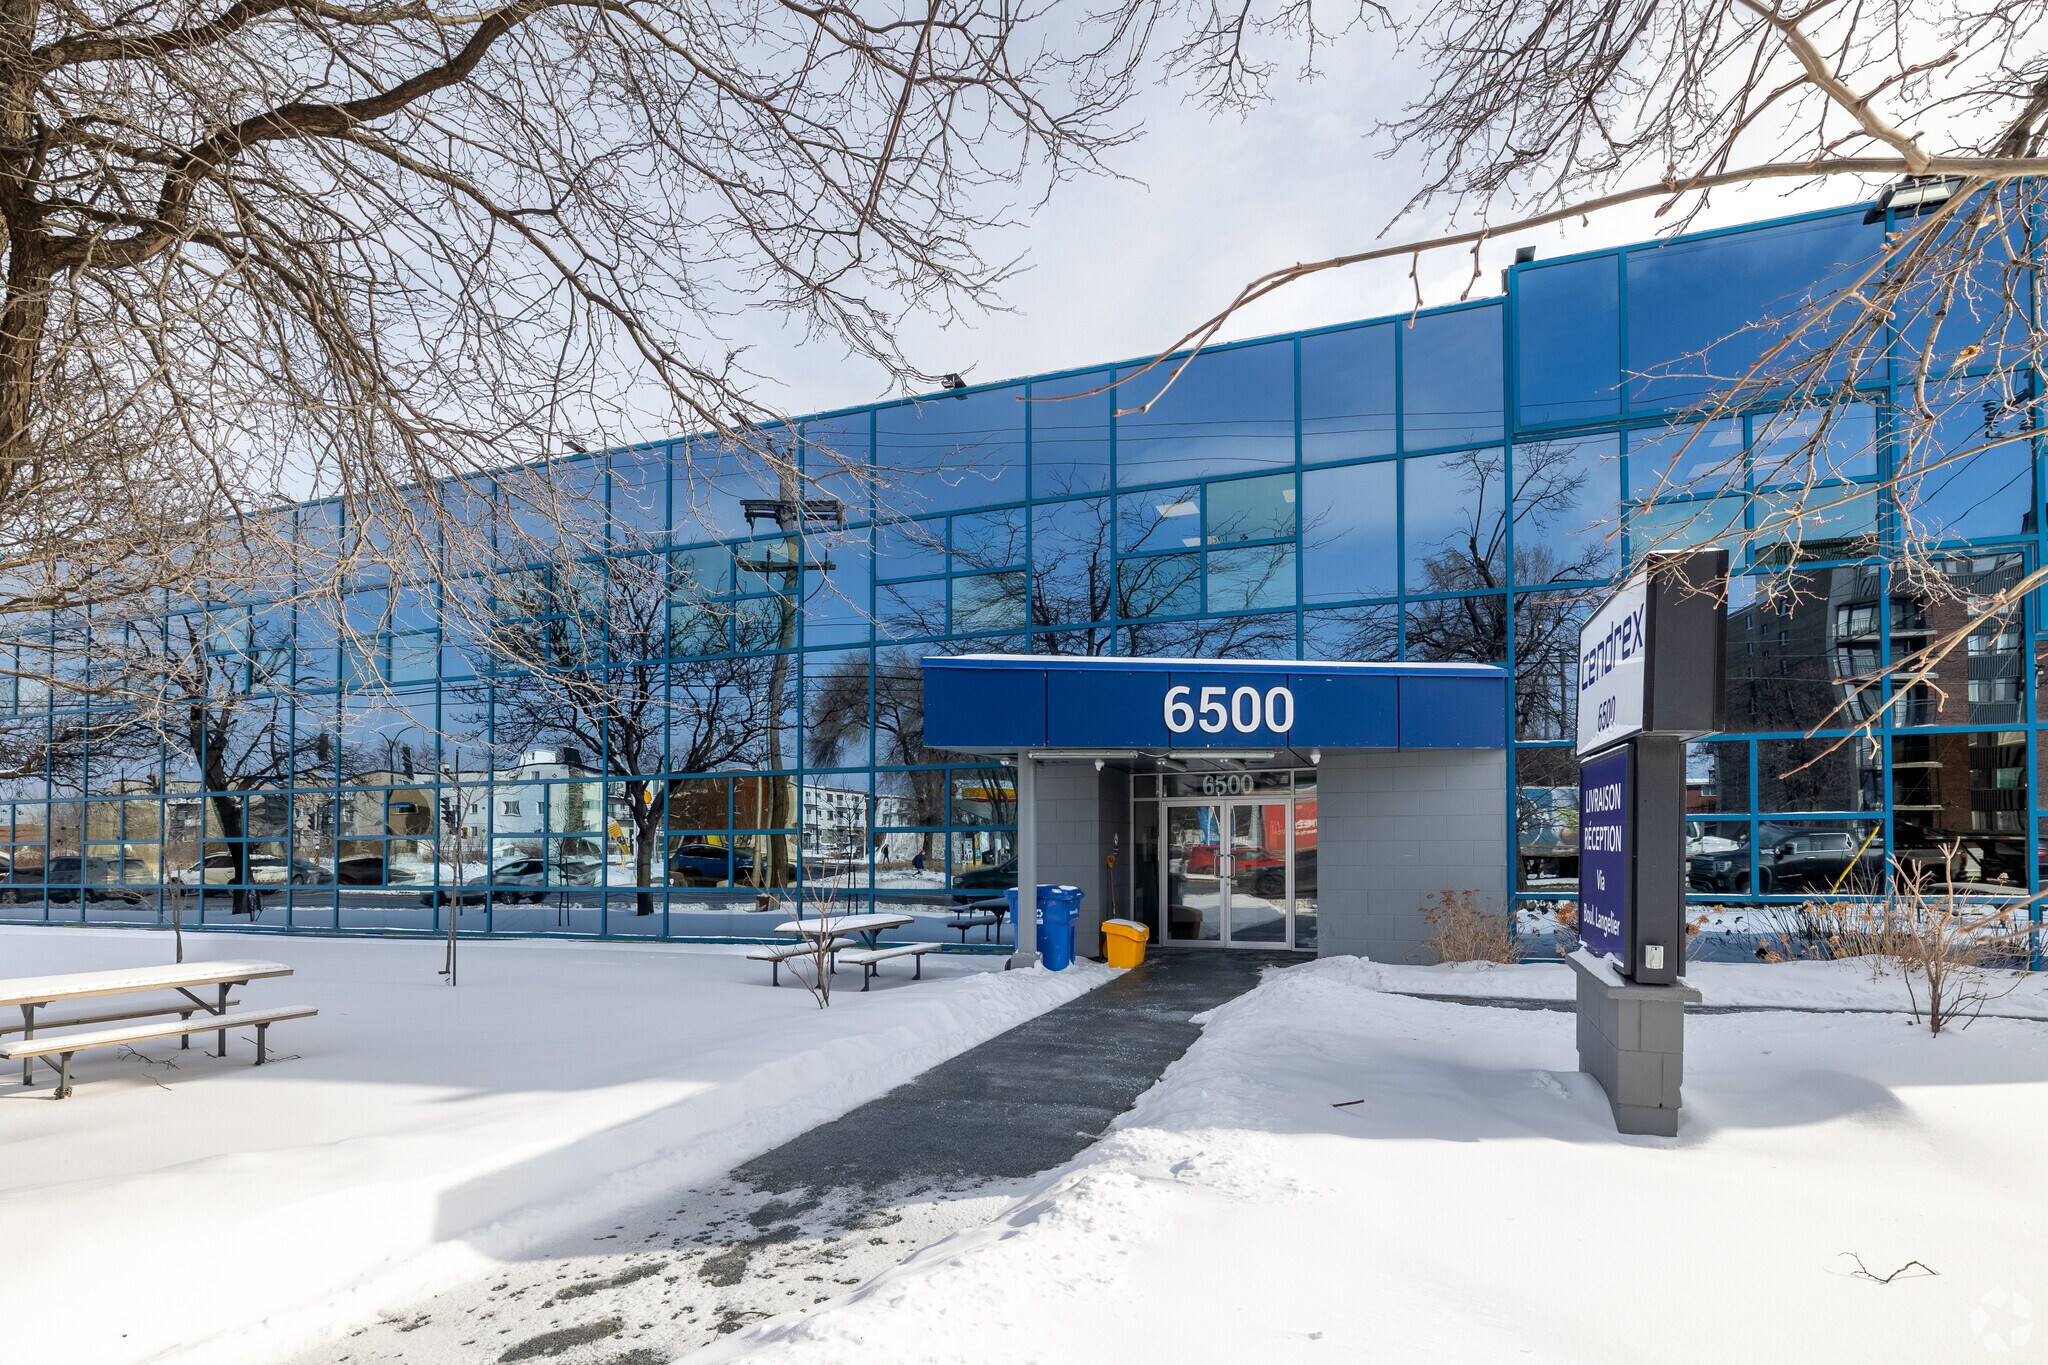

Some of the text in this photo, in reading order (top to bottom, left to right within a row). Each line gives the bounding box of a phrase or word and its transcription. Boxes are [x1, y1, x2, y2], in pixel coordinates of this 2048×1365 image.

[1164, 686, 1294, 733] 6500
[1598, 695, 1616, 732] 6500
[1202, 774, 1254, 795] 6500
[1585, 783, 1622, 813] LIVRAISON
[1584, 820, 1622, 852] RÉCEPTION
[1596, 869, 1606, 891] Via
[1583, 902, 1620, 938] Boul. Langelier
